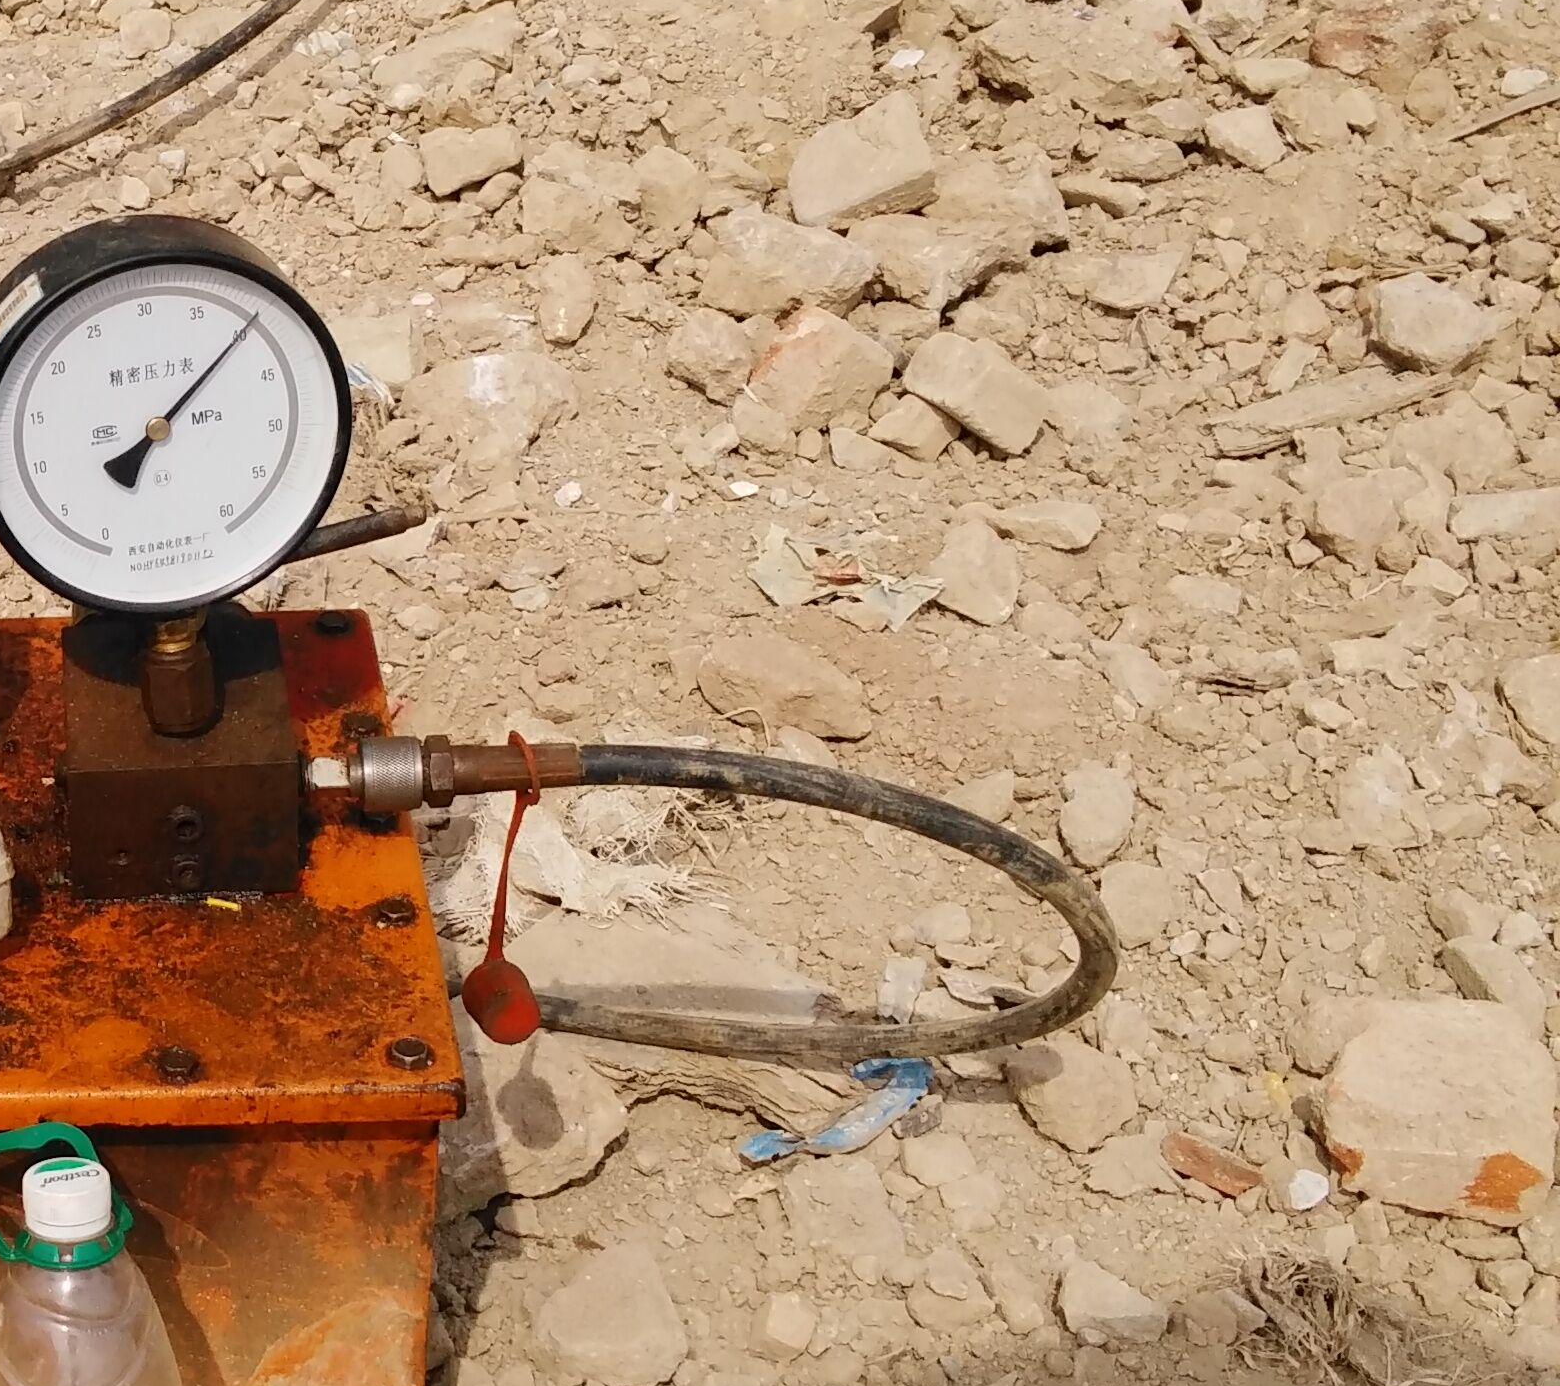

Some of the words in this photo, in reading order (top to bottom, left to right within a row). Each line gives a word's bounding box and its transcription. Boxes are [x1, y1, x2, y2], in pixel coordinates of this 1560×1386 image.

[137, 303, 152, 317] 30
[190, 306, 204, 321] 35
[87, 325, 102, 339] 25
[232, 329, 247, 343] 40
[51, 361, 66, 375] 20
[109, 358, 194, 387] 精密压力表
[261, 368, 275, 382] 45
[31, 412, 44, 425] 15
[191, 410, 222, 425] MPa
[269, 419, 283, 433] 50
[34, 461, 47, 474] 10
[252, 466, 266, 479] 55
[61, 504, 68, 517] 5
[219, 504, 234, 517] 60
[101, 527, 110, 540] 0
